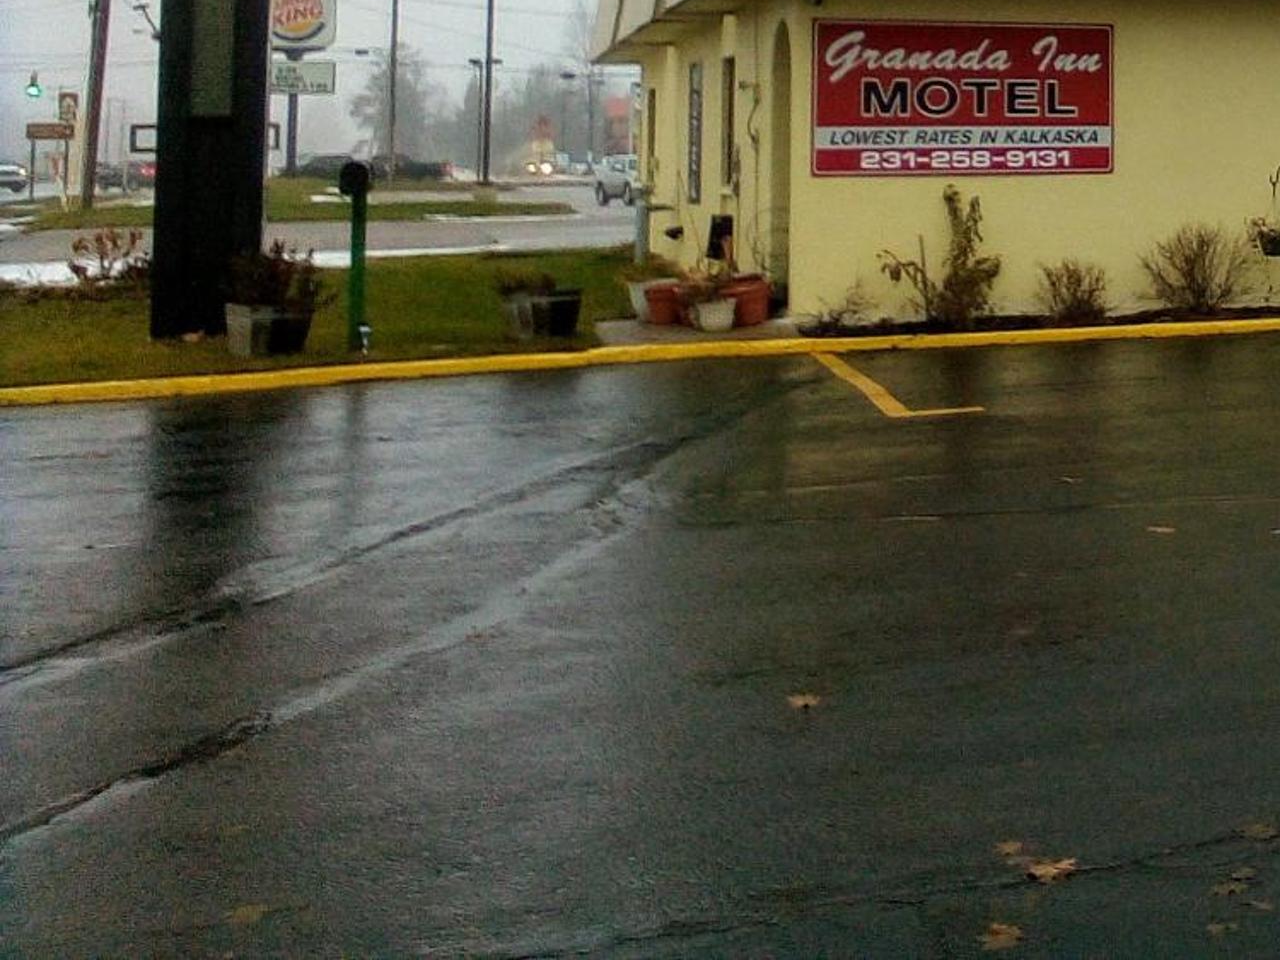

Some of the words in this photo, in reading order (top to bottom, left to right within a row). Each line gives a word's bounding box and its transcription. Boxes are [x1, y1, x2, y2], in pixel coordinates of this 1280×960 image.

[273, 5, 323, 28] KING
[824, 30, 1012, 83] Granada
[1031, 36, 1103, 73] Inn
[860, 77, 1079, 118] MOTEL
[829, 129, 908, 146] LOWEST
[914, 129, 973, 145] RATES
[979, 130, 999, 144] IN
[999, 129, 1100, 145] KALKASKA
[860, 149, 1072, 169] 231-258-9131
